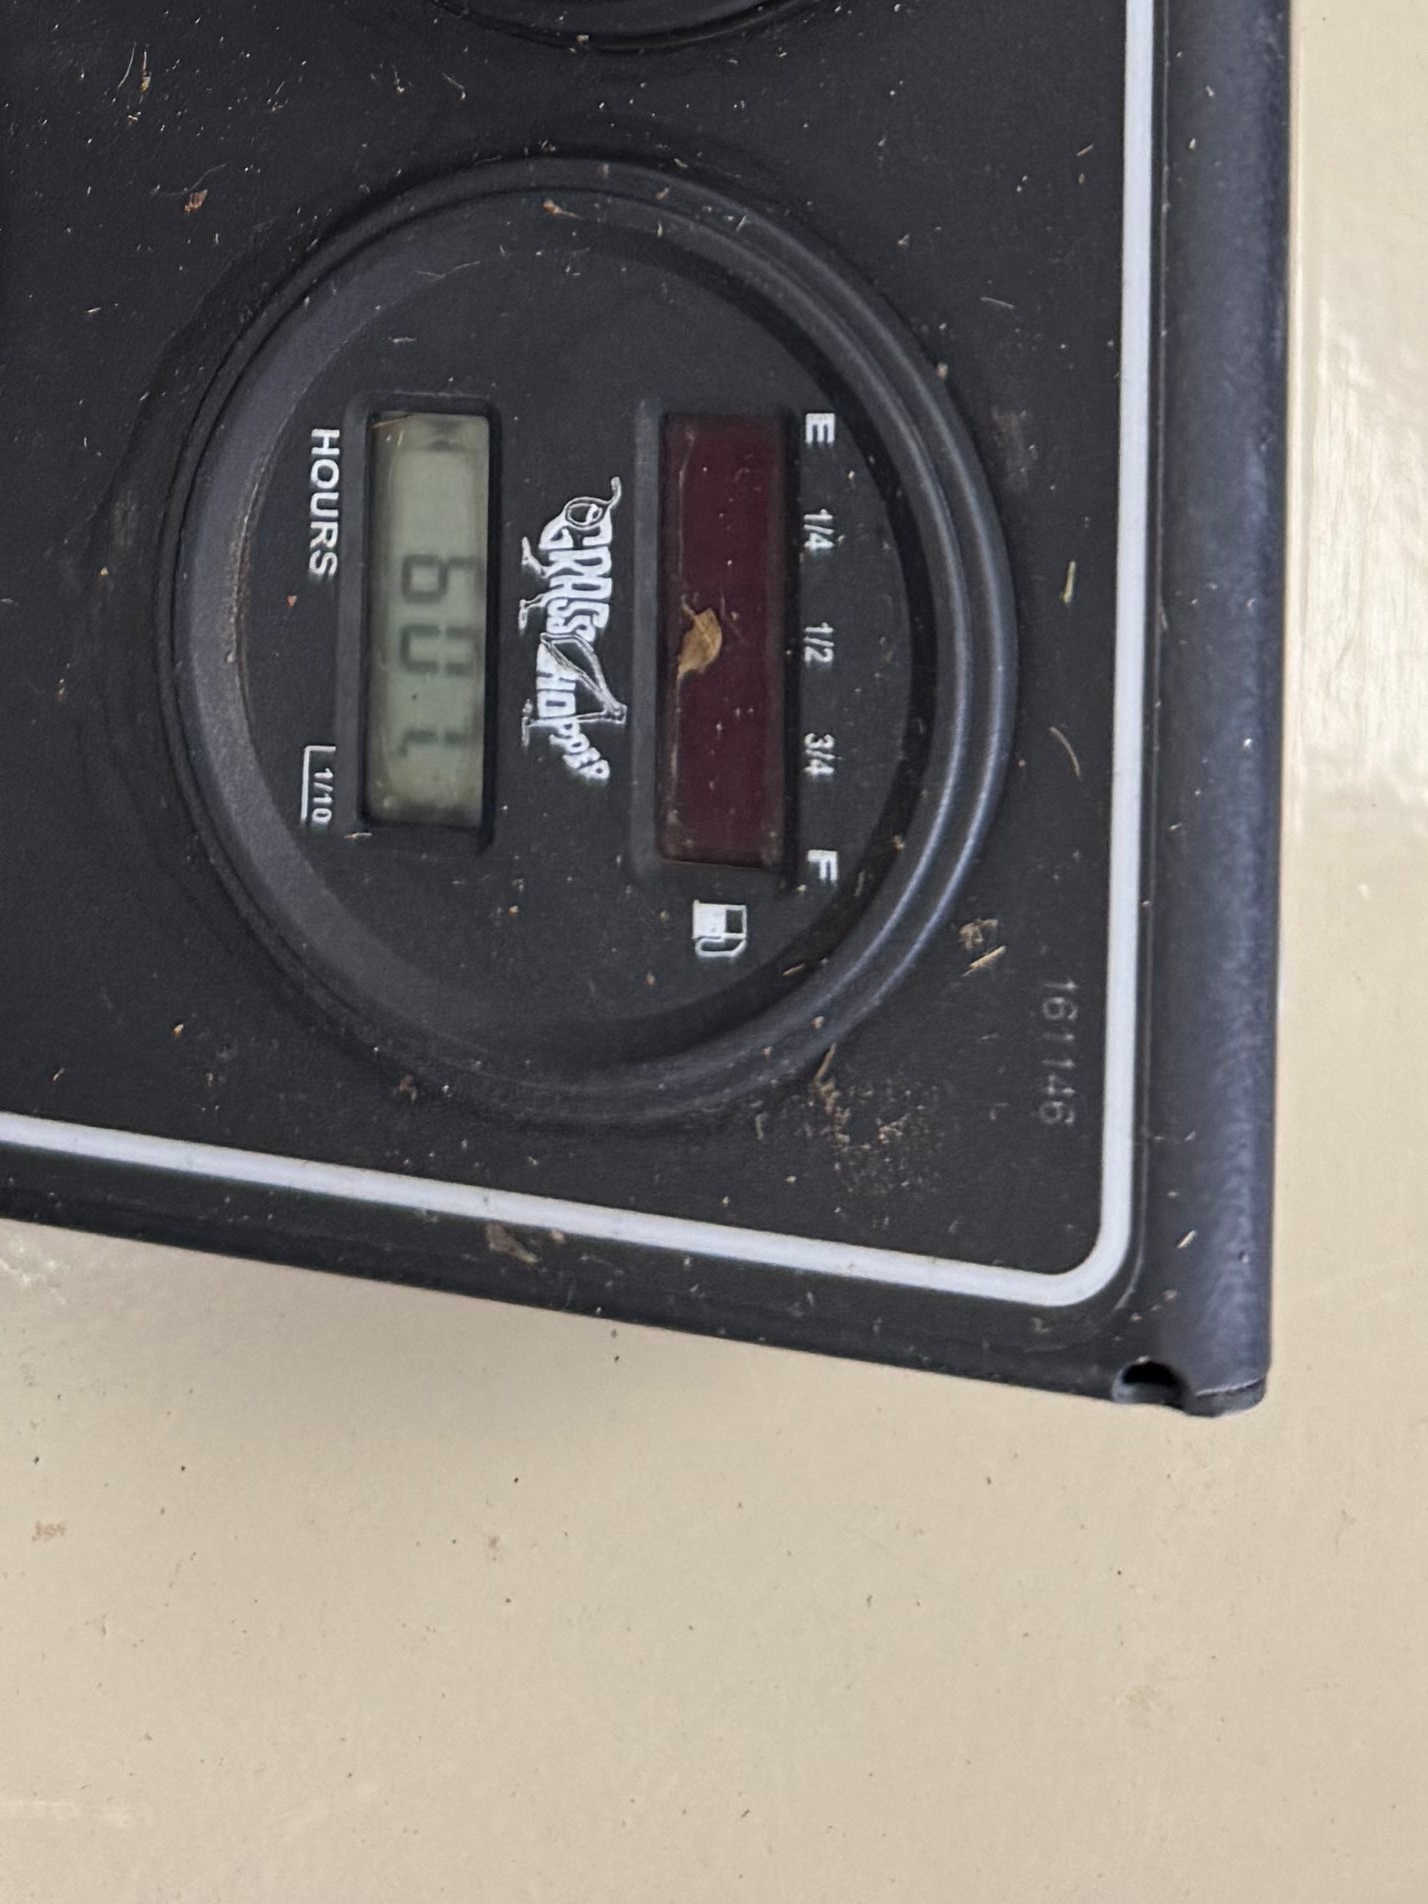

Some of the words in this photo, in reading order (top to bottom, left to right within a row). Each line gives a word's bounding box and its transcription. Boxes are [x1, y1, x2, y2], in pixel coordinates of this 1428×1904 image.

[805, 414, 836, 444] E
[306, 428, 340, 580] HOURS
[803, 510, 835, 551] 1/4
[803, 626, 835, 665] 1/2
[803, 733, 835, 776] 3/4
[310, 766, 334, 826] 1/10
[806, 851, 840, 883] F
[1039, 979, 1080, 1127] 161146
